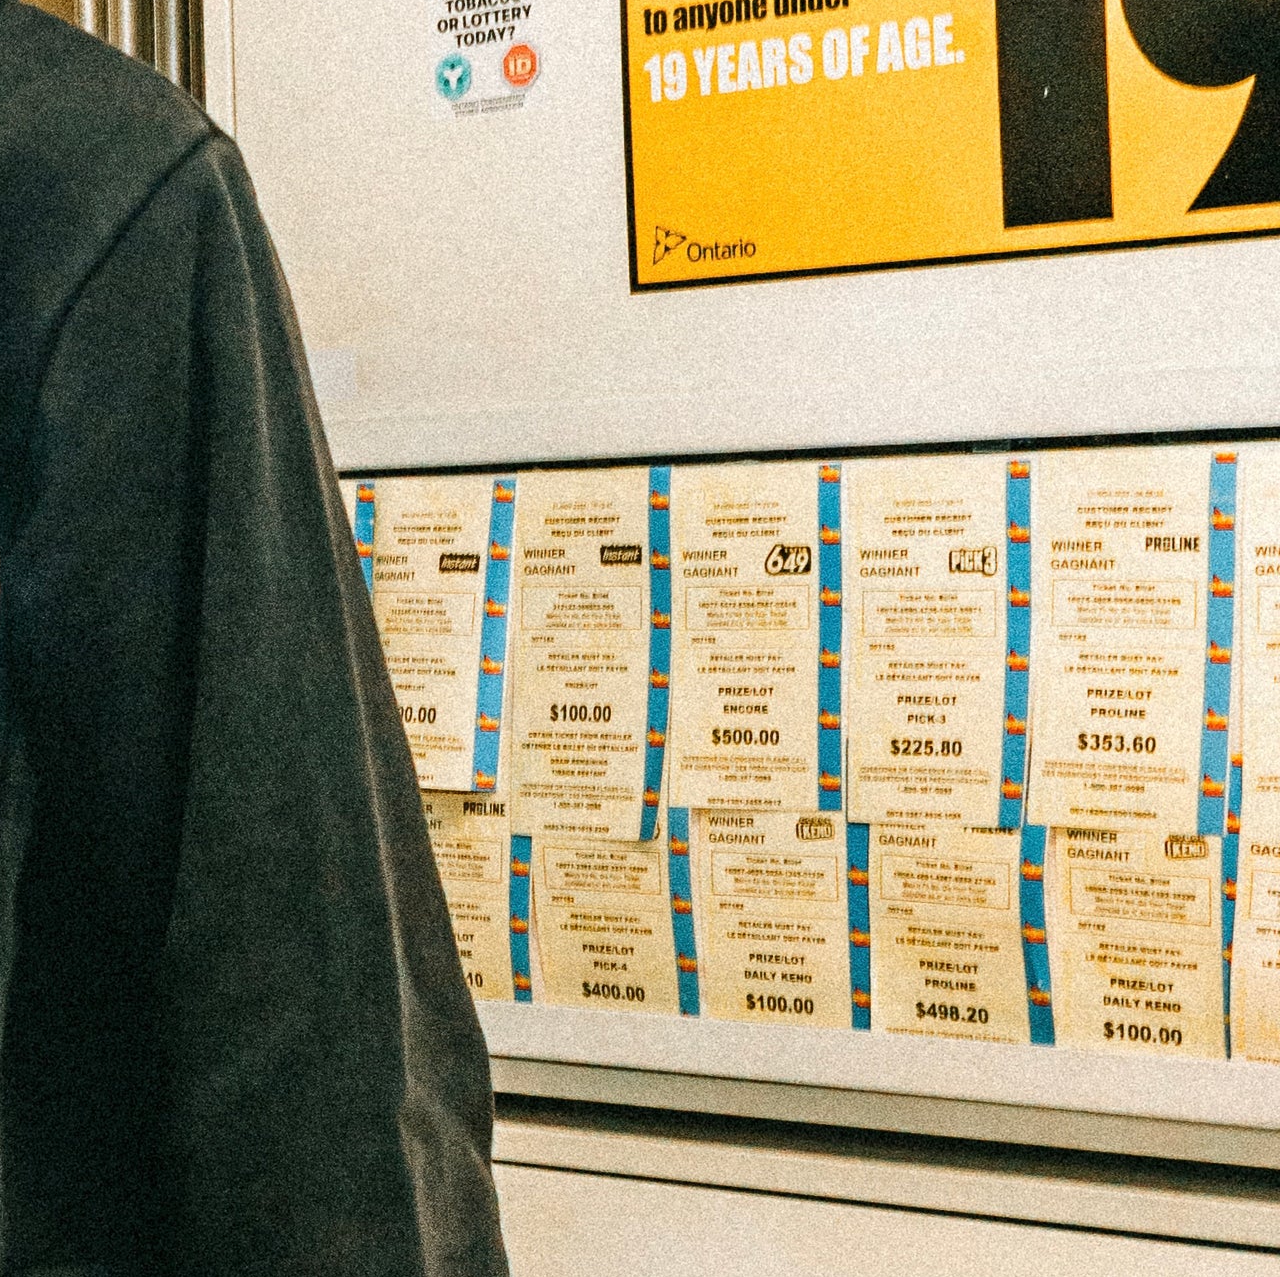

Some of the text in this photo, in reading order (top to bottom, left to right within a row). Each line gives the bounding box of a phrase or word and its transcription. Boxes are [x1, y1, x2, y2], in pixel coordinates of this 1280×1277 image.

[436, 4, 532, 35] OR LOTTERY
[643, 5, 668, 36] to
[454, 25, 516, 49] TODAY?
[508, 55, 532, 77] ID
[643, 11, 967, 104] 19 YEARS OF AGE.
[686, 238, 757, 263] Ontario
[523, 547, 567, 561] WINNER
[1050, 536, 1201, 554] WINNER PROLINE
[682, 549, 728, 562] WINNER
[859, 548, 909, 562] WINNER
[524, 563, 578, 578] GAGNANT
[682, 566, 739, 580] GAGNANT
[859, 565, 921, 579] GAGNANT
[1050, 558, 1116, 572] GAGNANT
[549, 703, 613, 724] $100.00
[722, 703, 770, 717] ENCORE
[1090, 705, 1148, 720] PROLINE
[711, 727, 781, 748] $500.00
[1077, 732, 1158, 756] $353.60
[889, 738, 964, 759] $225.80
[463, 800, 506, 819] PROLINE
[708, 814, 756, 830] WINNER
[708, 832, 767, 846] GAGNANT
[1067, 828, 1119, 844] WINNER
[744, 969, 778, 983] DAILY
[924, 978, 977, 993] PROLINE
[582, 981, 646, 1003] $400.00
[745, 993, 815, 1016] $100.00
[915, 1001, 989, 1025] $498.20
[1102, 995, 1182, 1014] DAILY KENO
[1103, 1021, 1184, 1048] $100.00
